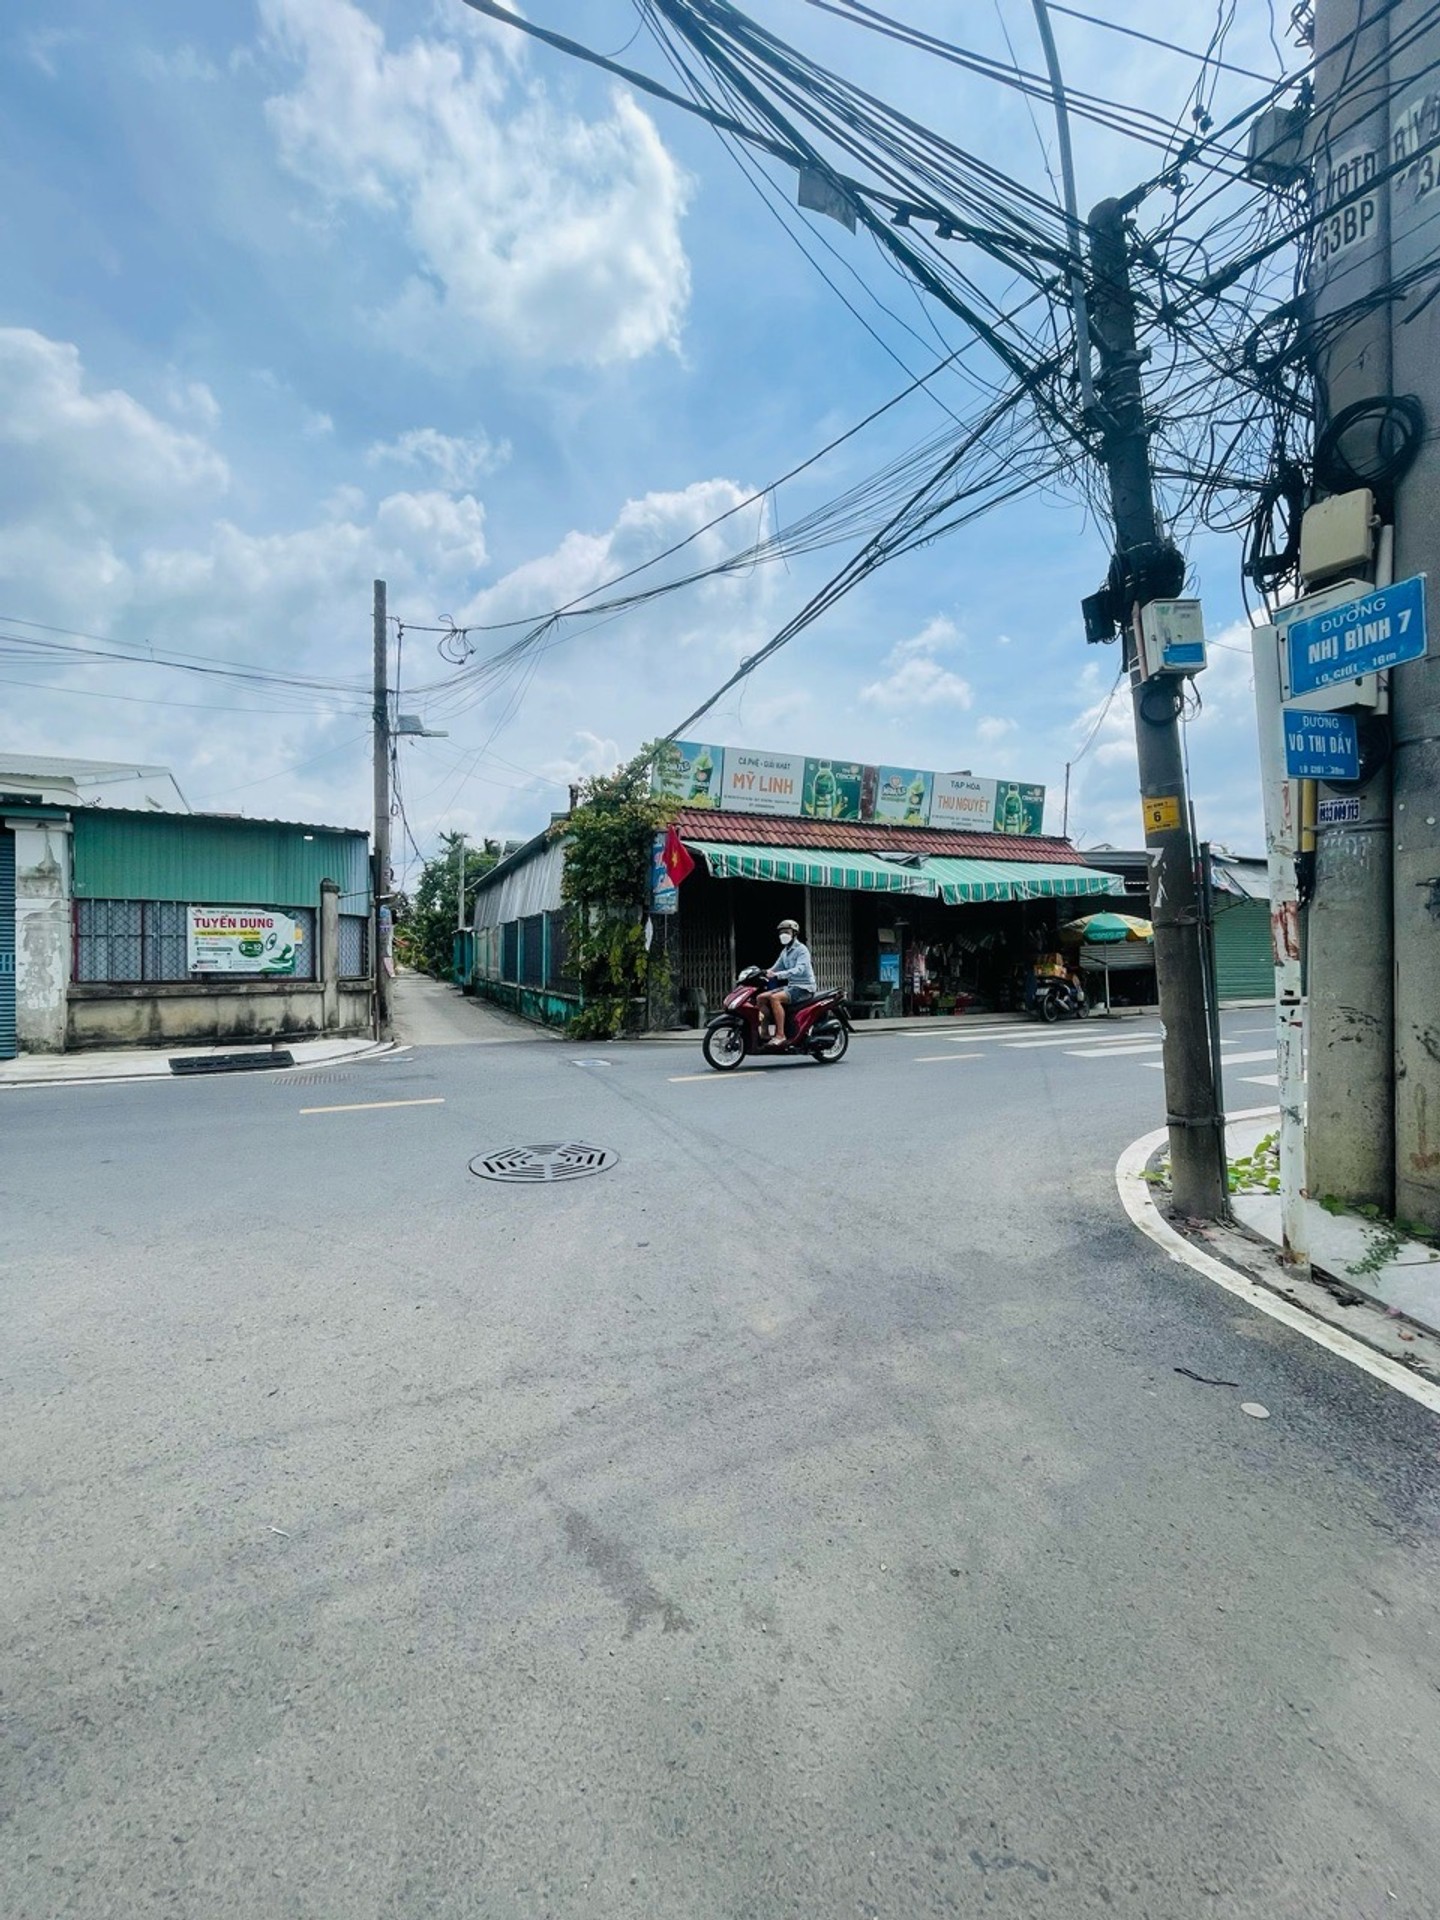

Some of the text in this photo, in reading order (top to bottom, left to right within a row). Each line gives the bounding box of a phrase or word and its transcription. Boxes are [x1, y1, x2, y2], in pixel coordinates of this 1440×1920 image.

[1321, 598, 1386, 632] ĐƯỜNG
[1308, 608, 1412, 664] NHỊ BÌNH 7
[1303, 713, 1339, 729] ĐƯỜNG
[1308, 734, 1326, 757] THỊ
[733, 771, 793, 795] MỸ LINH
[951, 780, 965, 790] TẠP
[938, 795, 990, 816] THU NGUYỆT
[1153, 811, 1162, 822] 6
[193, 914, 274, 930] TUYỂN DỤNG
